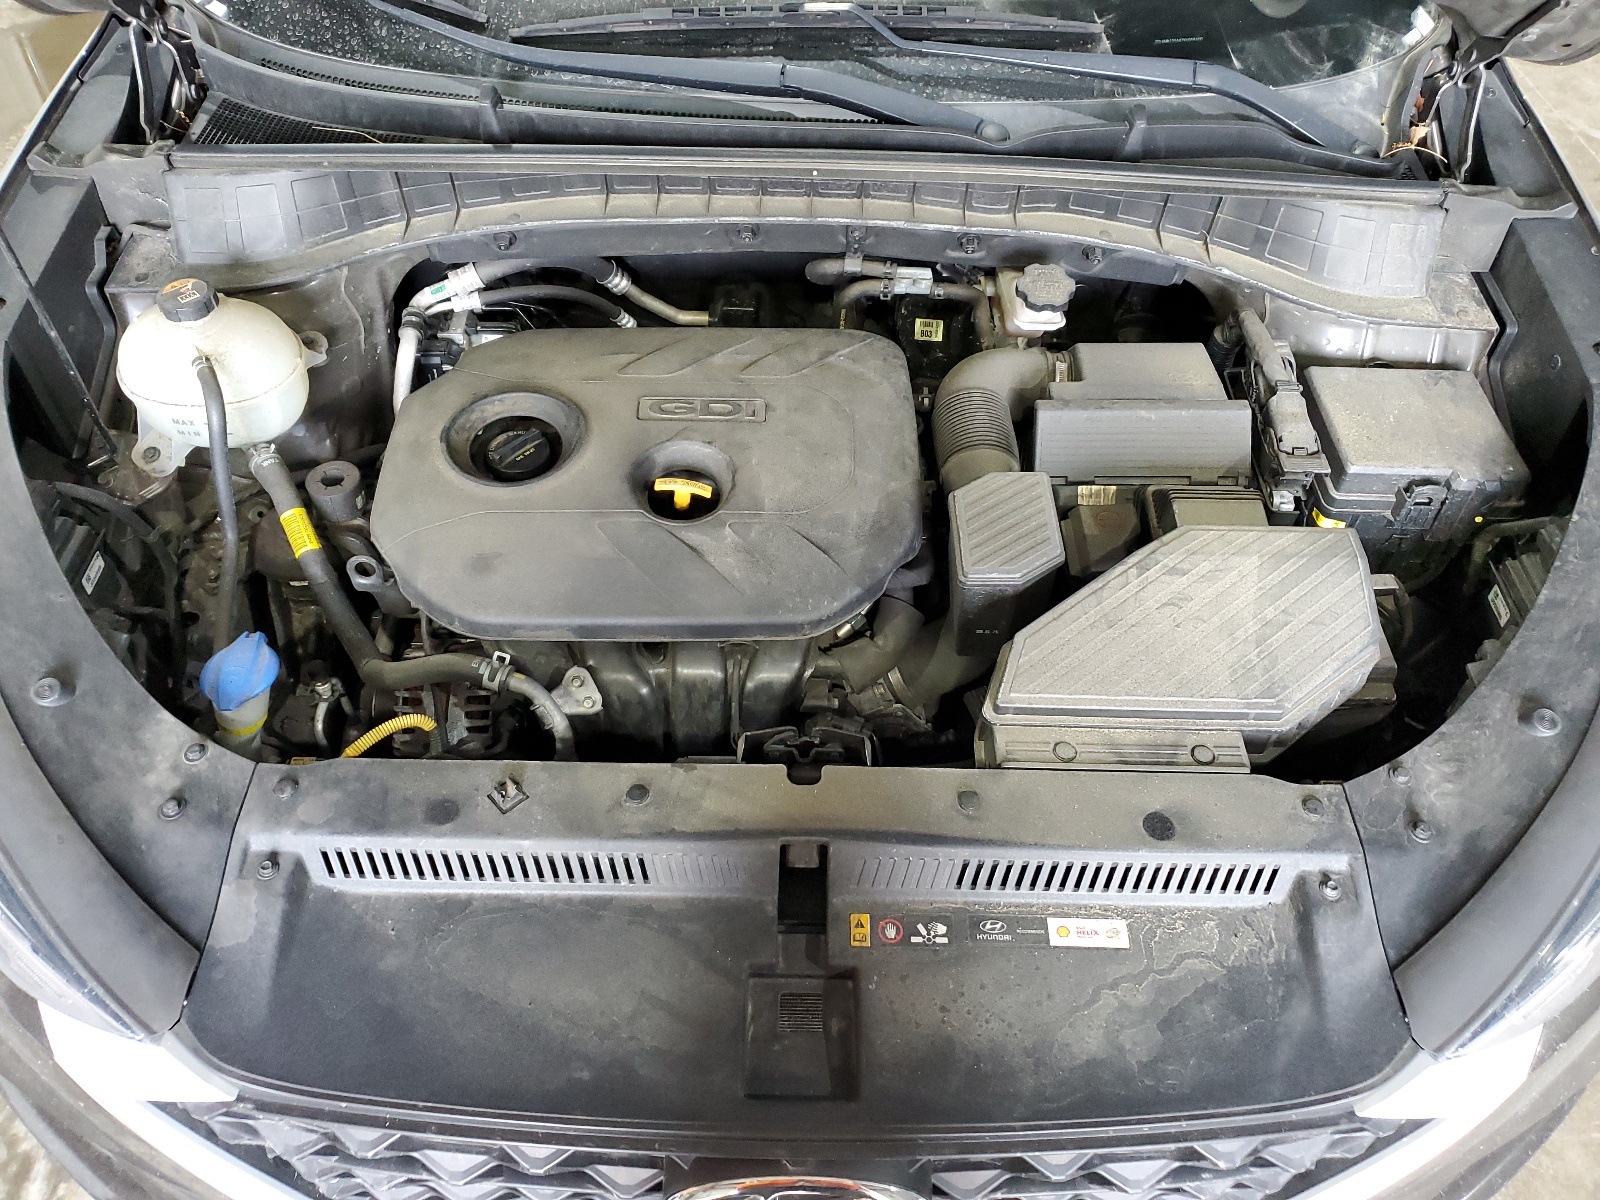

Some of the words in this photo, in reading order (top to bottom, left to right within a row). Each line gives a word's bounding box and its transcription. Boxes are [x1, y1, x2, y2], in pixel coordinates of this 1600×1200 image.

[647, 400, 757, 419] GDI
[171, 418, 196, 427] MAX
[177, 429, 201, 437] MIN
[976, 933, 1012, 941] HYUNDAI
